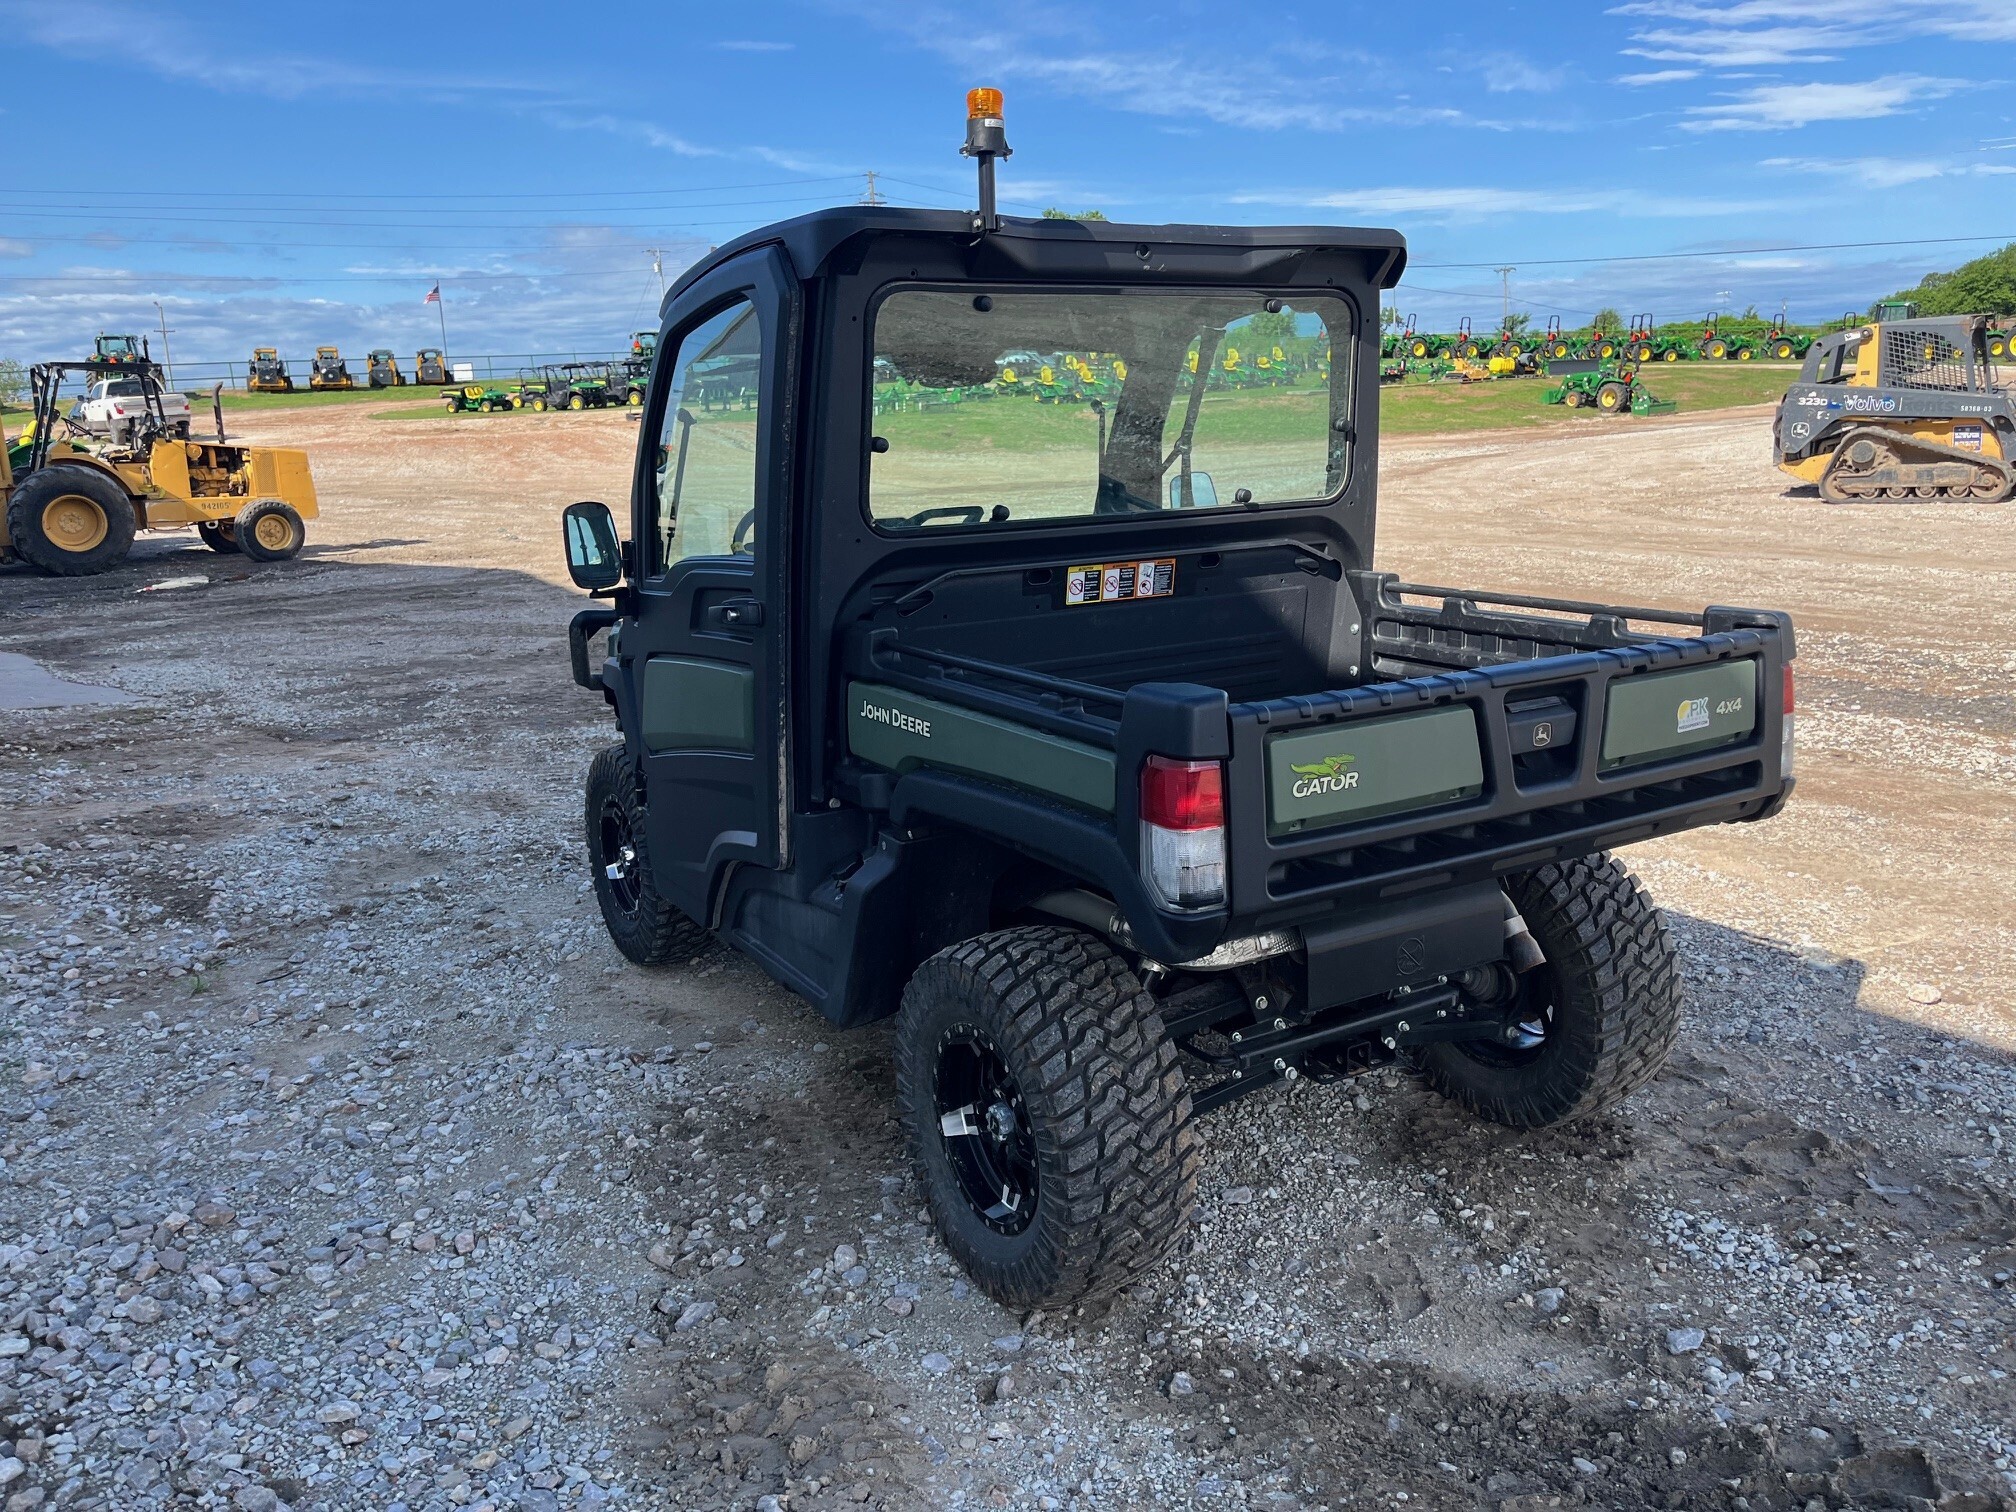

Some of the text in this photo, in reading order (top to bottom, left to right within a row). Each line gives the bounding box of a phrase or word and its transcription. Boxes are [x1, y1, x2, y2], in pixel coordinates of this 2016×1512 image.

[1798, 397, 1828, 406] 323D
[1843, 394, 1895, 412] Volvo
[860, 700, 931, 738] JOHN DEERE
[1292, 771, 1359, 798] GATOR
